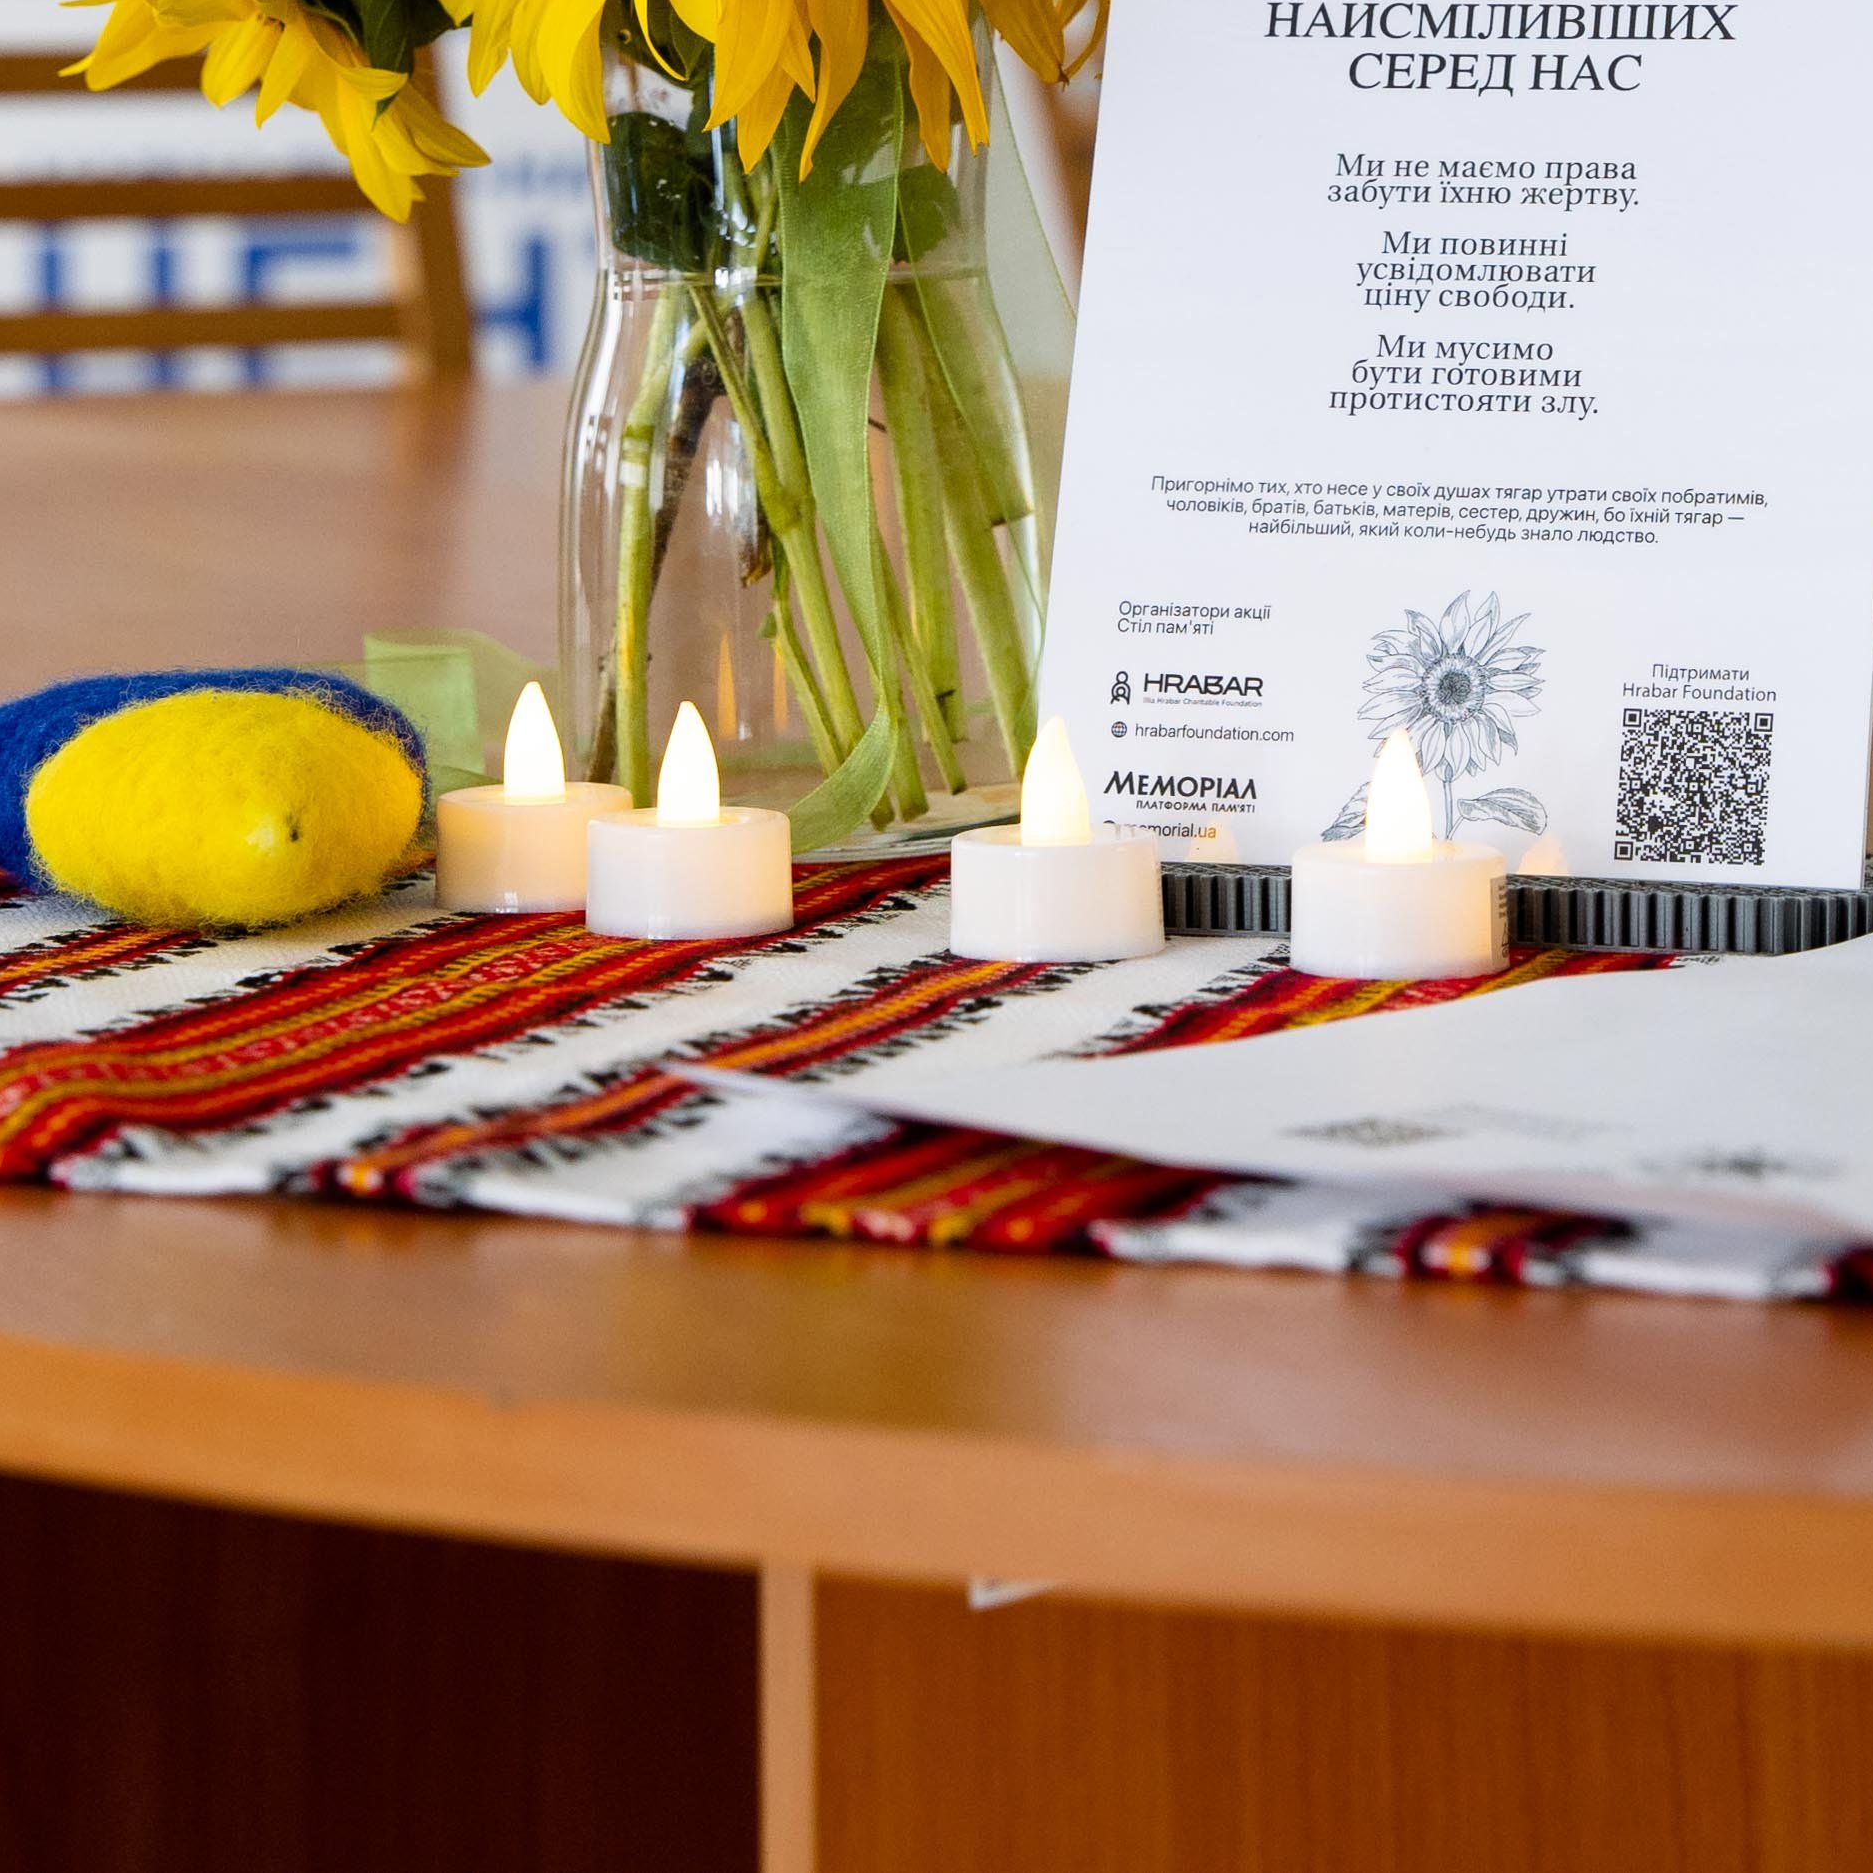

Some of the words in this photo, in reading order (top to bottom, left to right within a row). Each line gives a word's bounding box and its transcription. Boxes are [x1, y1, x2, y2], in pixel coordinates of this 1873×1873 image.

[1348, 52, 1518, 98] СЕРЕД
[1527, 53, 1643, 92] НАС
[1335, 152, 1386, 177] Ми
[1392, 159, 1430, 178] не
[1437, 160, 1536, 180] маємо
[1544, 161, 1638, 187] права
[1327, 177, 1432, 210] забути
[1439, 180, 1512, 205] їхню
[1520, 186, 1639, 213] жертву.
[1380, 230, 1432, 256] Ми
[1439, 232, 1568, 257] повинні
[1355, 256, 1597, 287] усвідомлювати
[1363, 281, 1432, 314] ціну
[1438, 282, 1575, 313] свободи.
[1375, 334, 1427, 359] Ми
[1434, 341, 1554, 367] мусимо
[1351, 358, 1423, 391] бути
[1430, 367, 1583, 388] готовими
[1328, 390, 1533, 417] протистояти
[1541, 395, 1599, 422] злу.
[1151, 475, 1255, 495] Пригорнімо
[1257, 481, 1290, 497] тих,
[1293, 482, 1323, 495] хто
[1326, 483, 1369, 497] несе
[1372, 484, 1383, 500] у
[1386, 481, 1431, 498] своїх
[1432, 485, 1491, 502] душах
[1494, 487, 1543, 504] тягар
[1546, 488, 1608, 504] утрати
[1611, 487, 1658, 503] своїх
[1661, 487, 1768, 508] побратимів,
[1166, 497, 1248, 516] чоловіків,
[1251, 497, 1309, 517] братів,
[1313, 499, 1379, 519] батьків,
[1382, 504, 1455, 521] матерів,
[1458, 506, 1523, 524] сестер,
[1525, 508, 1600, 525] дружин,
[1603, 506, 1626, 523] бо
[1629, 507, 1670, 524] їхній
[1674, 511, 1724, 528] тягар
[1248, 518, 1355, 538] найбільший,
[1358, 521, 1400, 537] який
[1403, 523, 1517, 543] коли-небудь
[1520, 528, 1574, 542] знало
[1576, 529, 1659, 546] людство.
[1117, 617, 1152, 634] Стіл
[1155, 619, 1215, 636] пам'яті
[1118, 600, 1230, 621] Організатори
[1233, 605, 1272, 622] акції
[1143, 672, 1264, 698] HRABAR
[1652, 663, 1750, 683] Підтримати
[1622, 682, 1679, 699] Hrabar
[1682, 684, 1777, 702] Foundation
[1134, 723, 1295, 742] hrabarfoundation.com
[1135, 799, 1208, 812] ПЛАТФОРМА
[1211, 802, 1256, 814] ПАМ'ЯТІ
